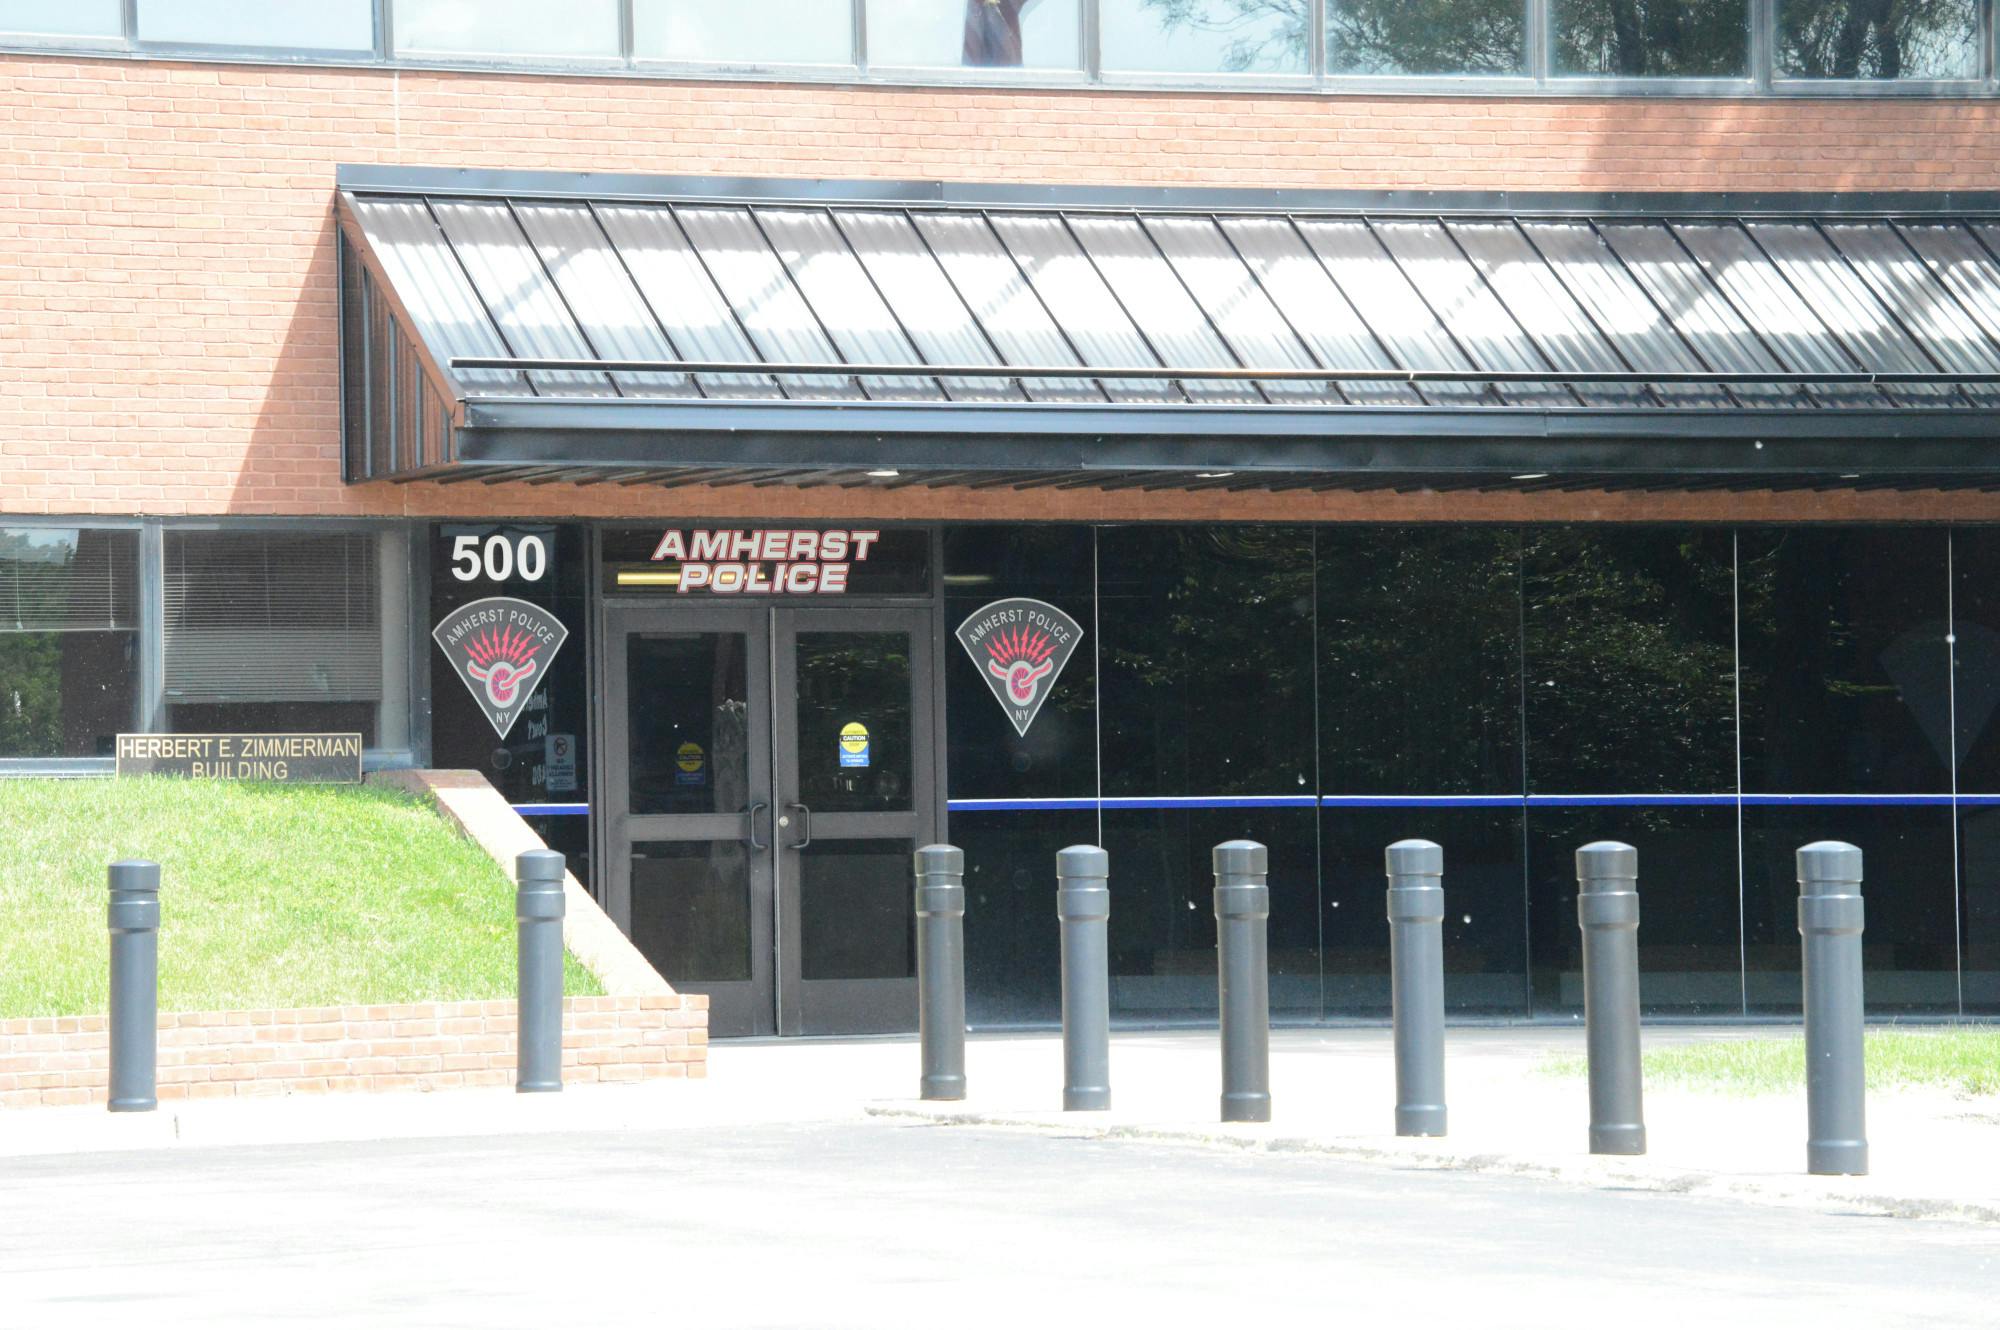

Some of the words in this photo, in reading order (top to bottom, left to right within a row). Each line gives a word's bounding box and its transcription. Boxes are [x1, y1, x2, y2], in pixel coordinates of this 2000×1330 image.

[452, 535, 546, 582] 500
[651, 529, 880, 561] AMHERST
[676, 562, 850, 594] POLICE
[446, 608, 505, 645] AMHERST
[509, 610, 555, 645] POLICE
[969, 609, 1024, 645] AMHERST
[1028, 610, 1071, 645] POLICE
[496, 711, 510, 724] NY
[1015, 709, 1029, 721] NY
[121, 738, 213, 759] HERBERT
[219, 738, 235, 758] E.
[241, 738, 358, 757] ZIMMERMAN
[192, 761, 288, 780] BUILDING
